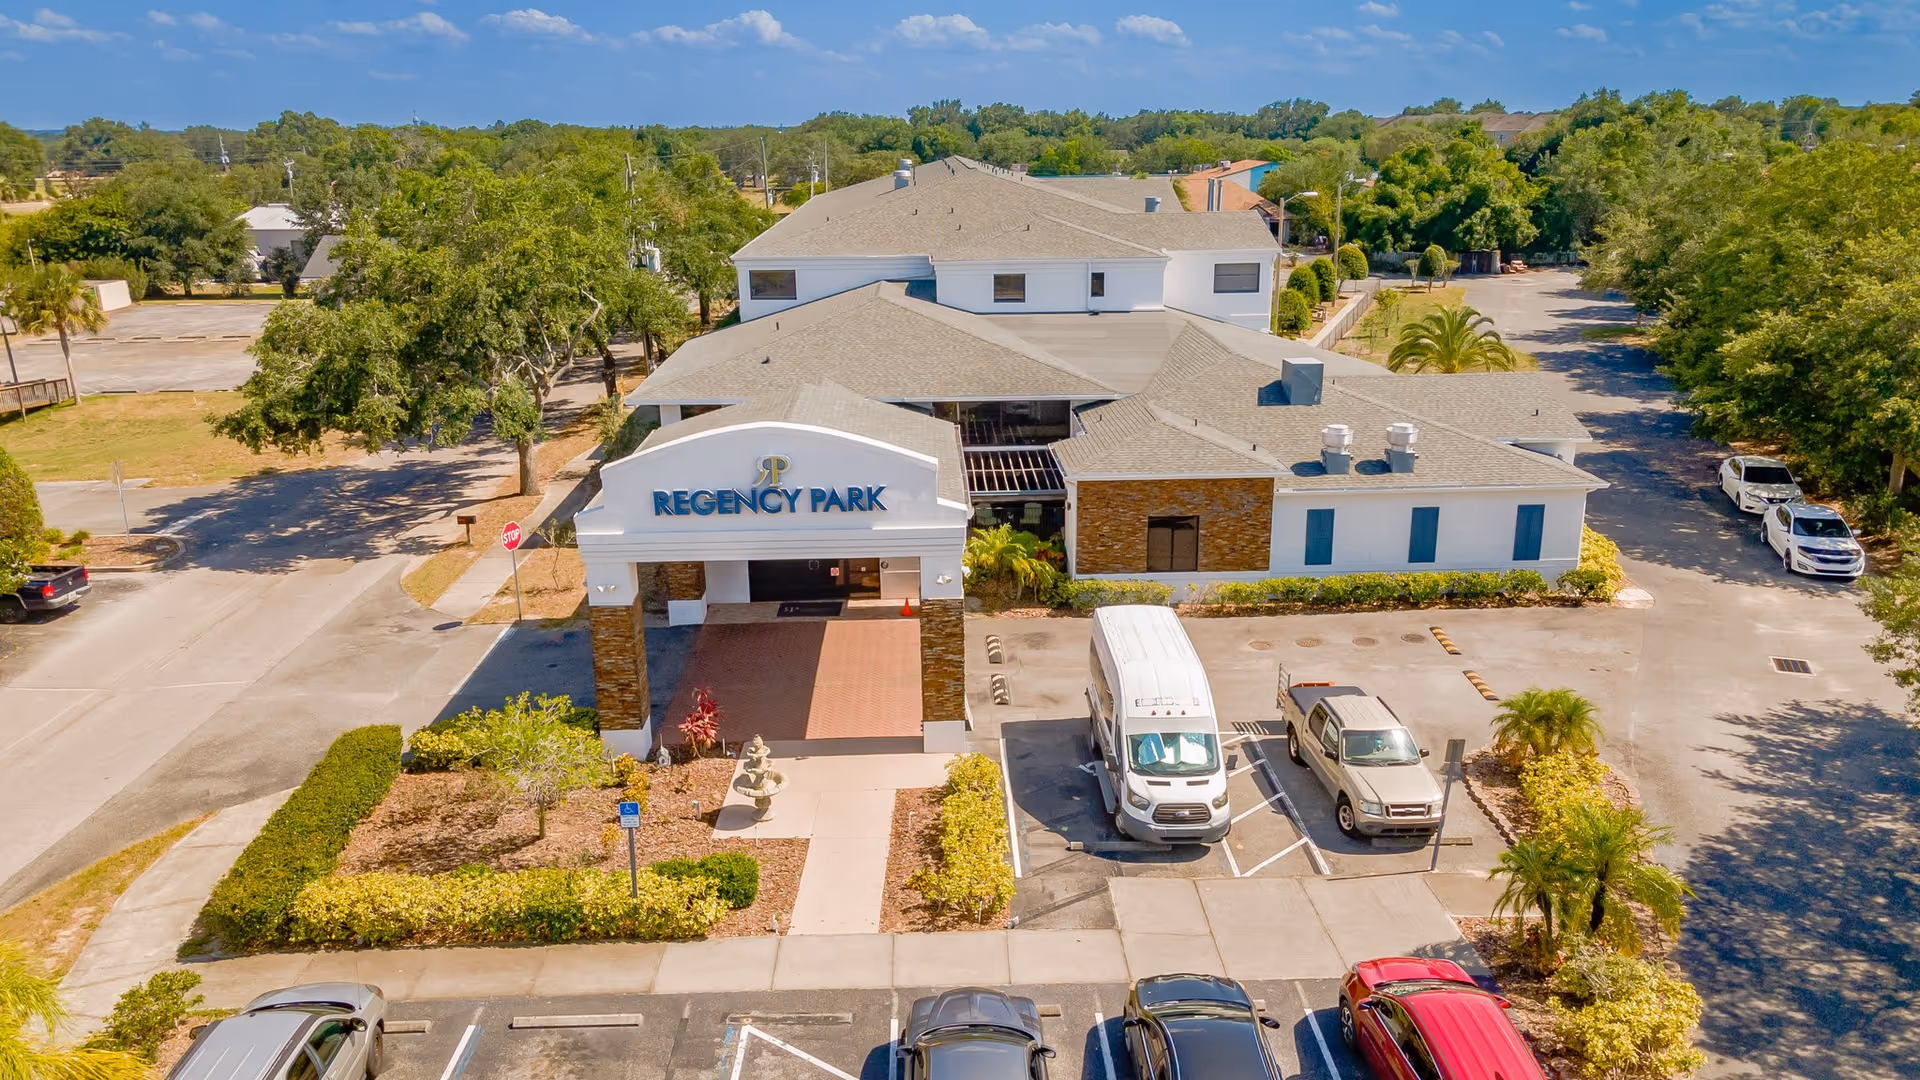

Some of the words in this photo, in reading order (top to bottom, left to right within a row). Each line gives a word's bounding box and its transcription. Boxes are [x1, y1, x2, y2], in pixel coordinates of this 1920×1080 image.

[653, 486, 802, 516] REGENCY
[810, 484, 887, 513] PARK
[503, 528, 520, 544] STOP
